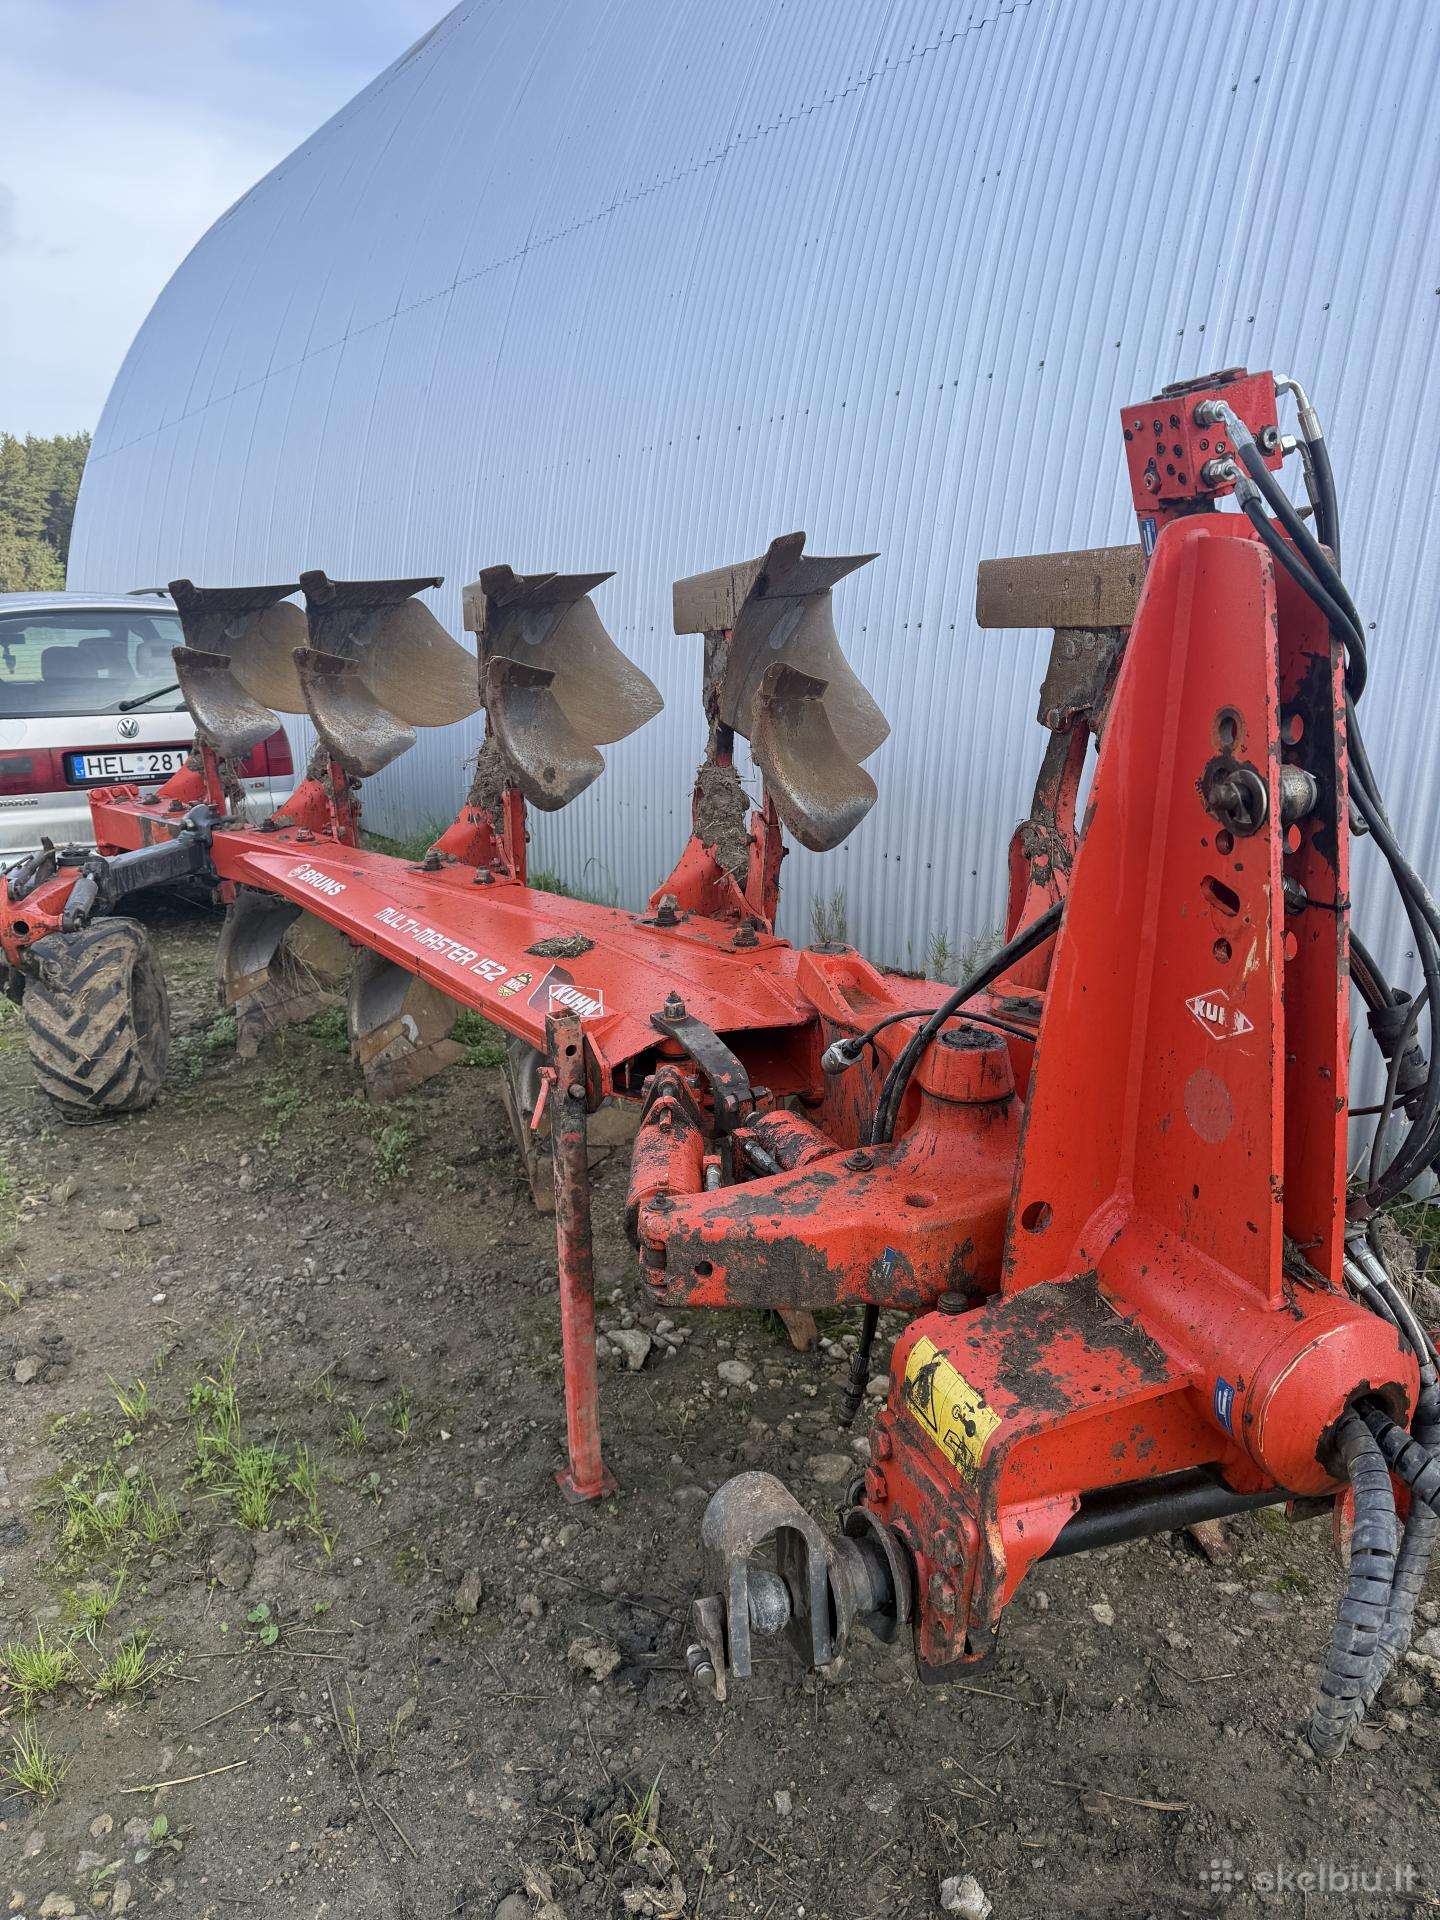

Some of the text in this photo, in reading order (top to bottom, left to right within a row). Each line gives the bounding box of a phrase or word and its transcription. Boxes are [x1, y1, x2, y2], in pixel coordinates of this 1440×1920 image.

[87, 753, 184, 776] HEL 281
[297, 869, 346, 895] BRUNS
[373, 907, 512, 982] MULTI-MASTER 152
[550, 986, 603, 1017] KUHN
